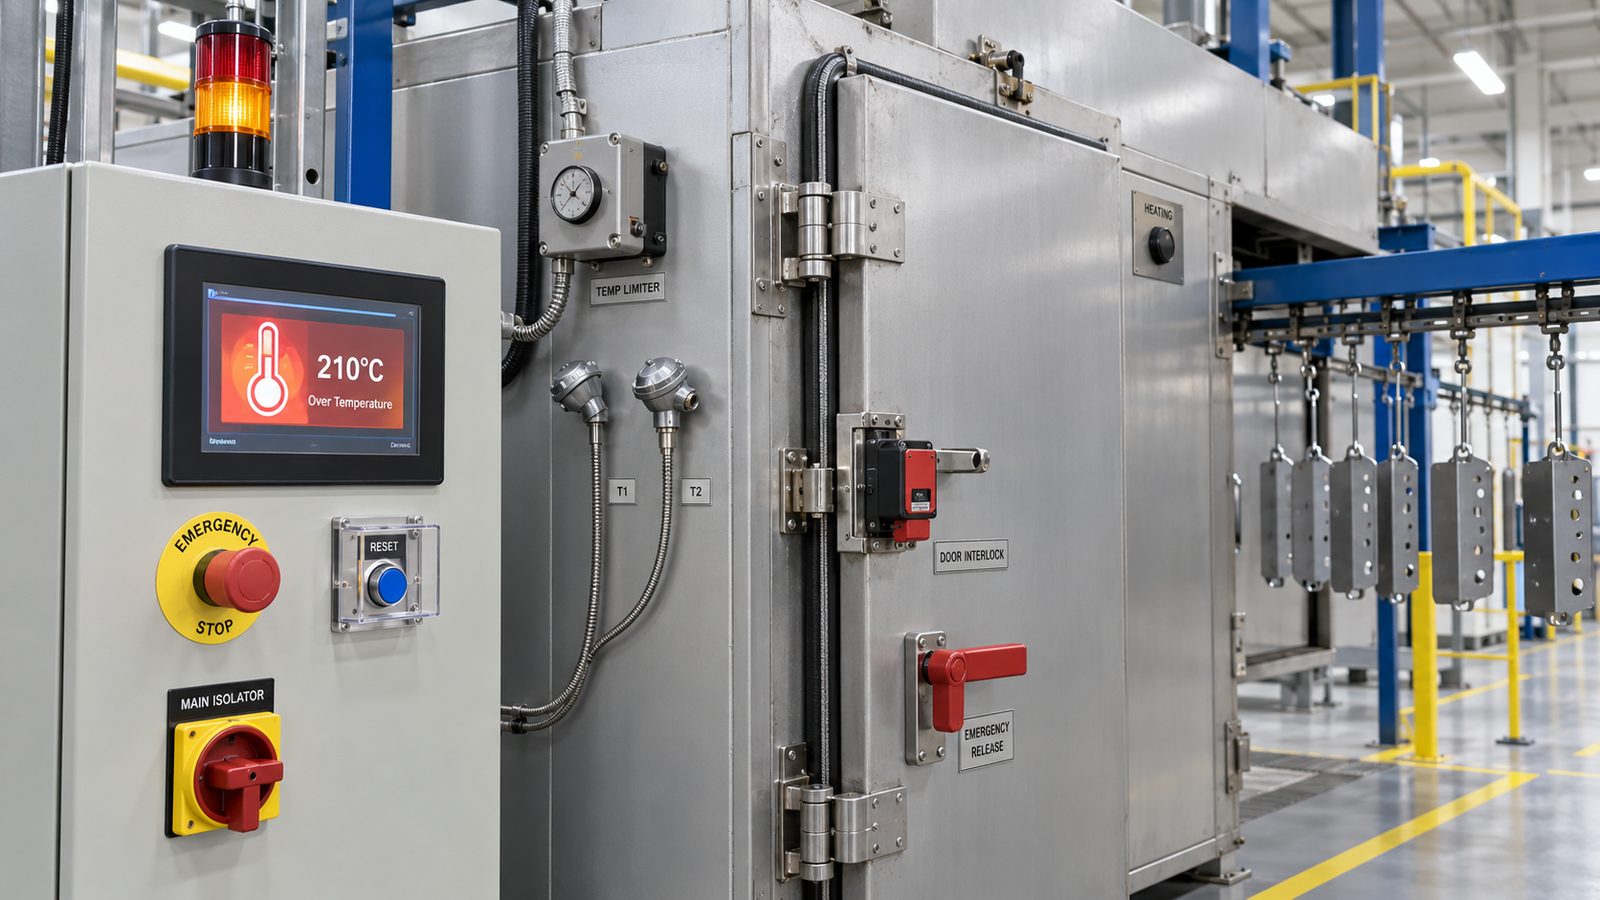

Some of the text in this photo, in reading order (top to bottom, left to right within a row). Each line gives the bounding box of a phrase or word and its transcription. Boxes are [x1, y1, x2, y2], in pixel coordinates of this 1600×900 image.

[1144, 203, 1173, 221] HEATING
[596, 282, 660, 297] TEMP LIMITER
[317, 354, 384, 382] 210°C
[308, 394, 393, 410] Over Temperature
[617, 486, 628, 497] T1
[690, 486, 702, 497] T2
[174, 518, 259, 553] EMERGENCY
[370, 541, 399, 552] RESET
[940, 549, 1005, 563] DOOR INTERLOCK
[196, 619, 233, 636] STOP
[181, 689, 265, 710] MAIN ISOLATOR
[965, 721, 1010, 741] EMERGENCY
[971, 740, 1004, 758] RELEASE
